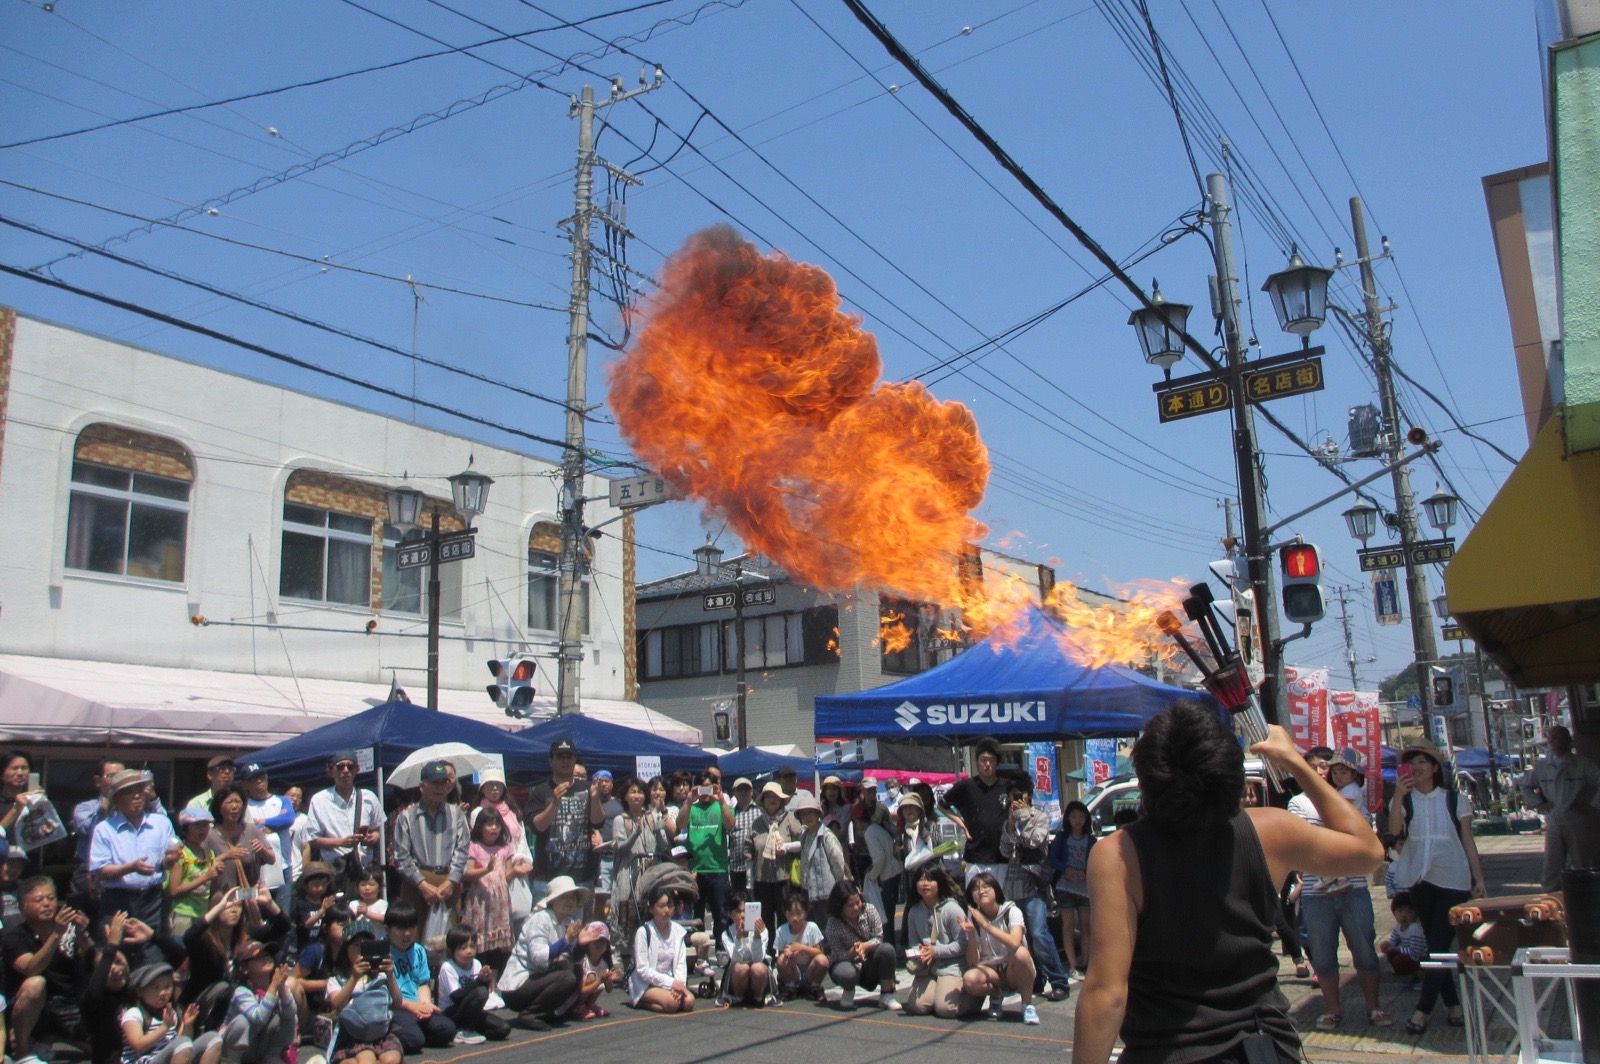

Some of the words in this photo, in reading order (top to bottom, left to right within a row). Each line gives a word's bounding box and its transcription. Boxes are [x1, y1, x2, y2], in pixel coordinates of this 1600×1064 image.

[1253, 366, 1314, 395] 名店街
[1168, 387, 1224, 413] 本通り
[620, 479, 664, 499] 五丁目
[401, 550, 428, 565] 本通り
[442, 541, 471, 558] 名店街
[1415, 547, 1452, 561] 名店街
[1365, 553, 1399, 567] 本通り
[706, 595, 732, 608] 本通り
[926, 701, 1046, 725] SUZUKI
[1311, 706, 1320, 726] TOTAL
